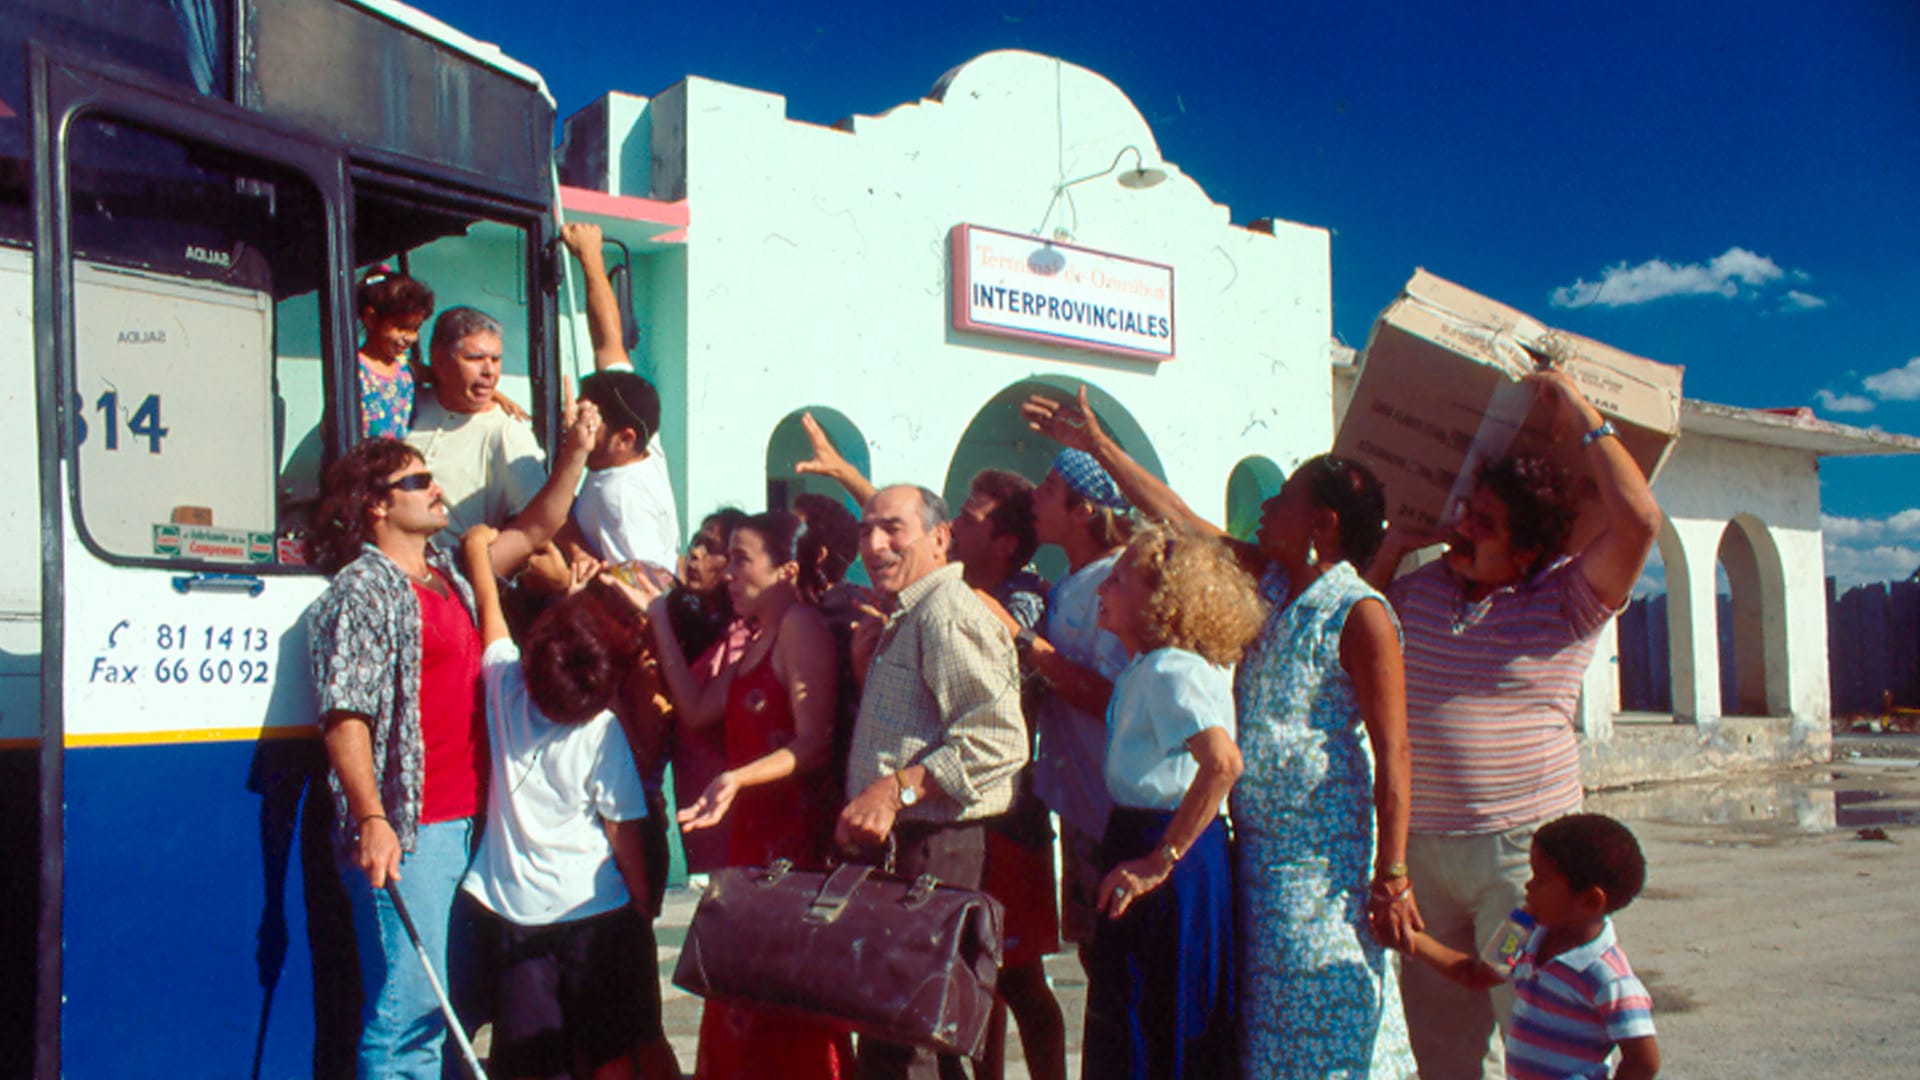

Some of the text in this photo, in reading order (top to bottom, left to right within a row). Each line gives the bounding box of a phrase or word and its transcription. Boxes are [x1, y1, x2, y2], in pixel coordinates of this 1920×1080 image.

[976, 244, 1058, 275] Terminal
[972, 283, 1171, 340] INTERPROVINCIALES
[156, 623, 187, 650] 81
[89, 657, 139, 684] Fax
[155, 657, 189, 684] 66
